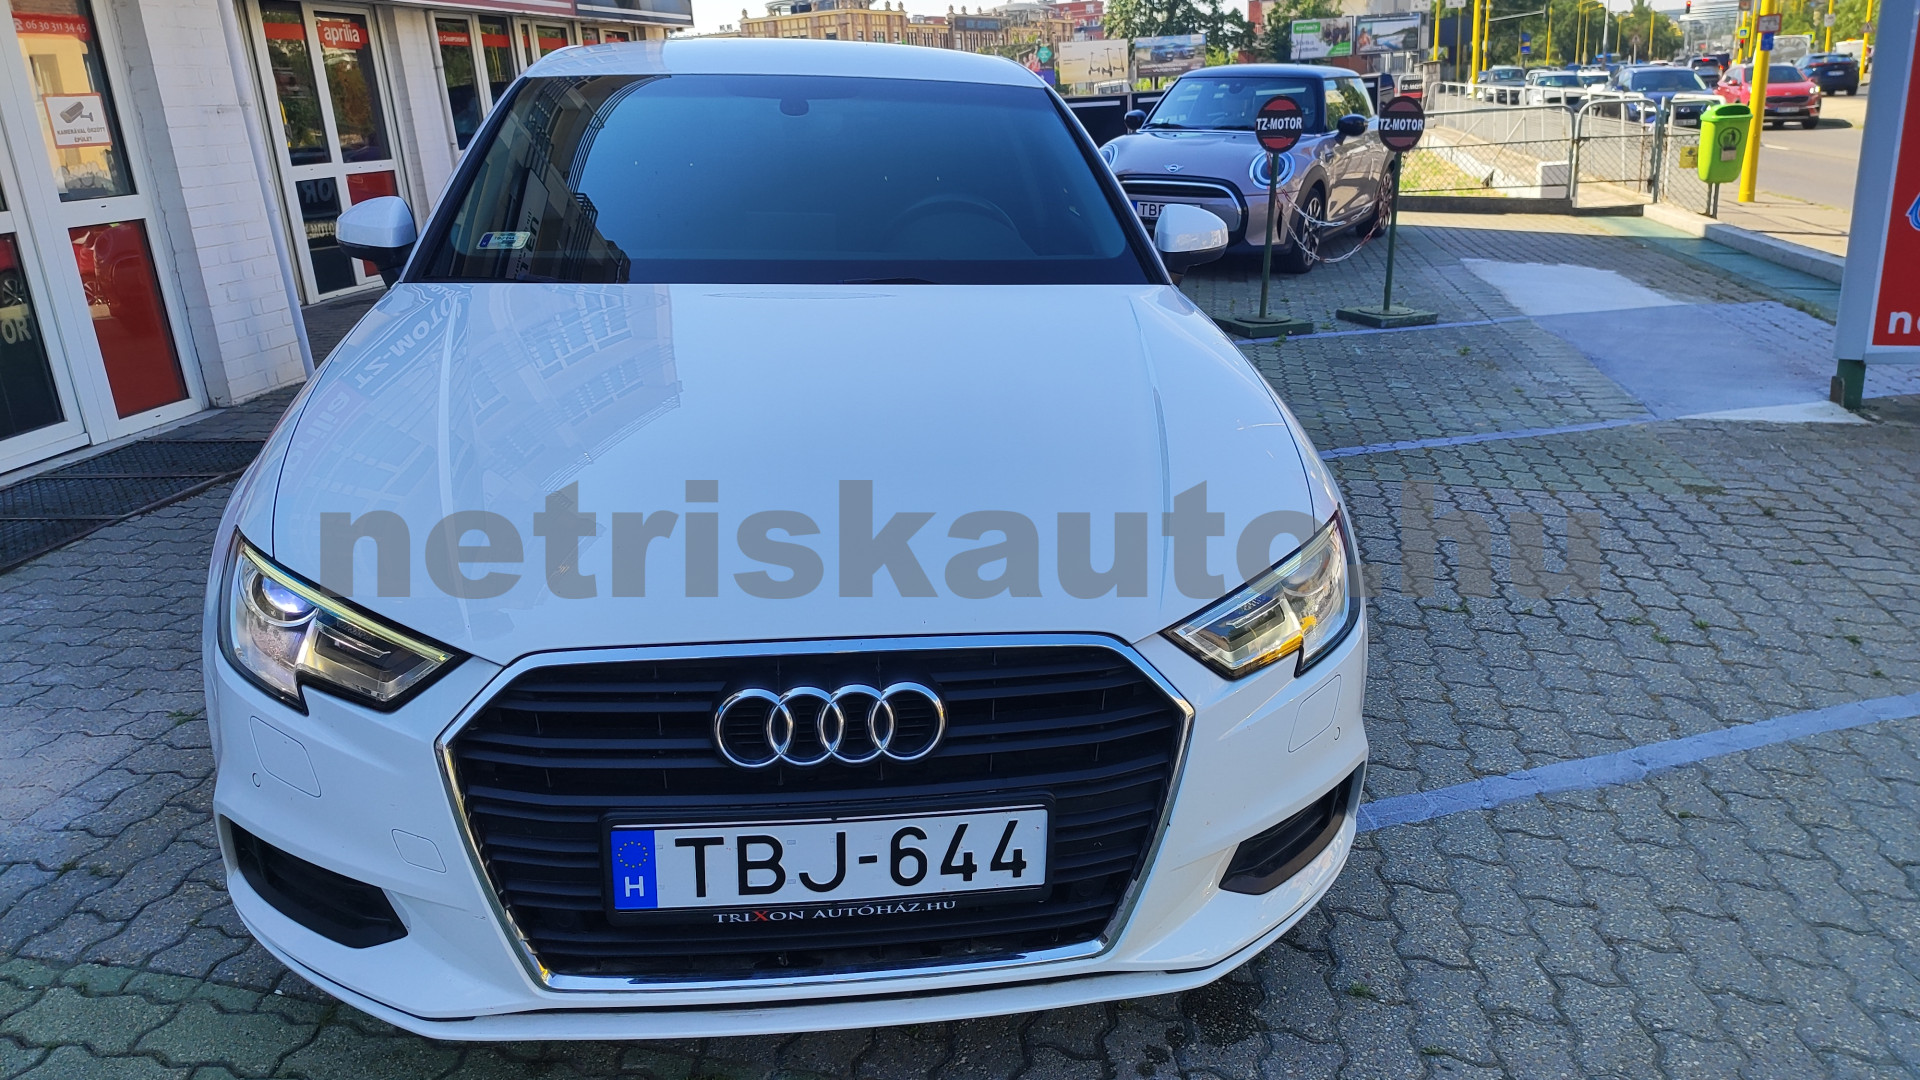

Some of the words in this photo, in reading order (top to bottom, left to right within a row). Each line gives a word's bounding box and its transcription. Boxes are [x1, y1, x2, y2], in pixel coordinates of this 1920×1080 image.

[25, 20, 37, 30] 06
[39, 21, 50, 32] 30
[51, 22, 63, 32] 311
[65, 23, 75, 33] 34
[76, 23, 87, 33] 45
[323, 23, 360, 46] aprilia
[1256, 117, 1303, 131] TZ-MOTOR
[1379, 118, 1424, 131] TZ-MOTOR
[674, 819, 1027, 898] TBJ-644
[624, 876, 644, 898] H
[812, 901, 957, 919] AUTÓHÁZ.HU
